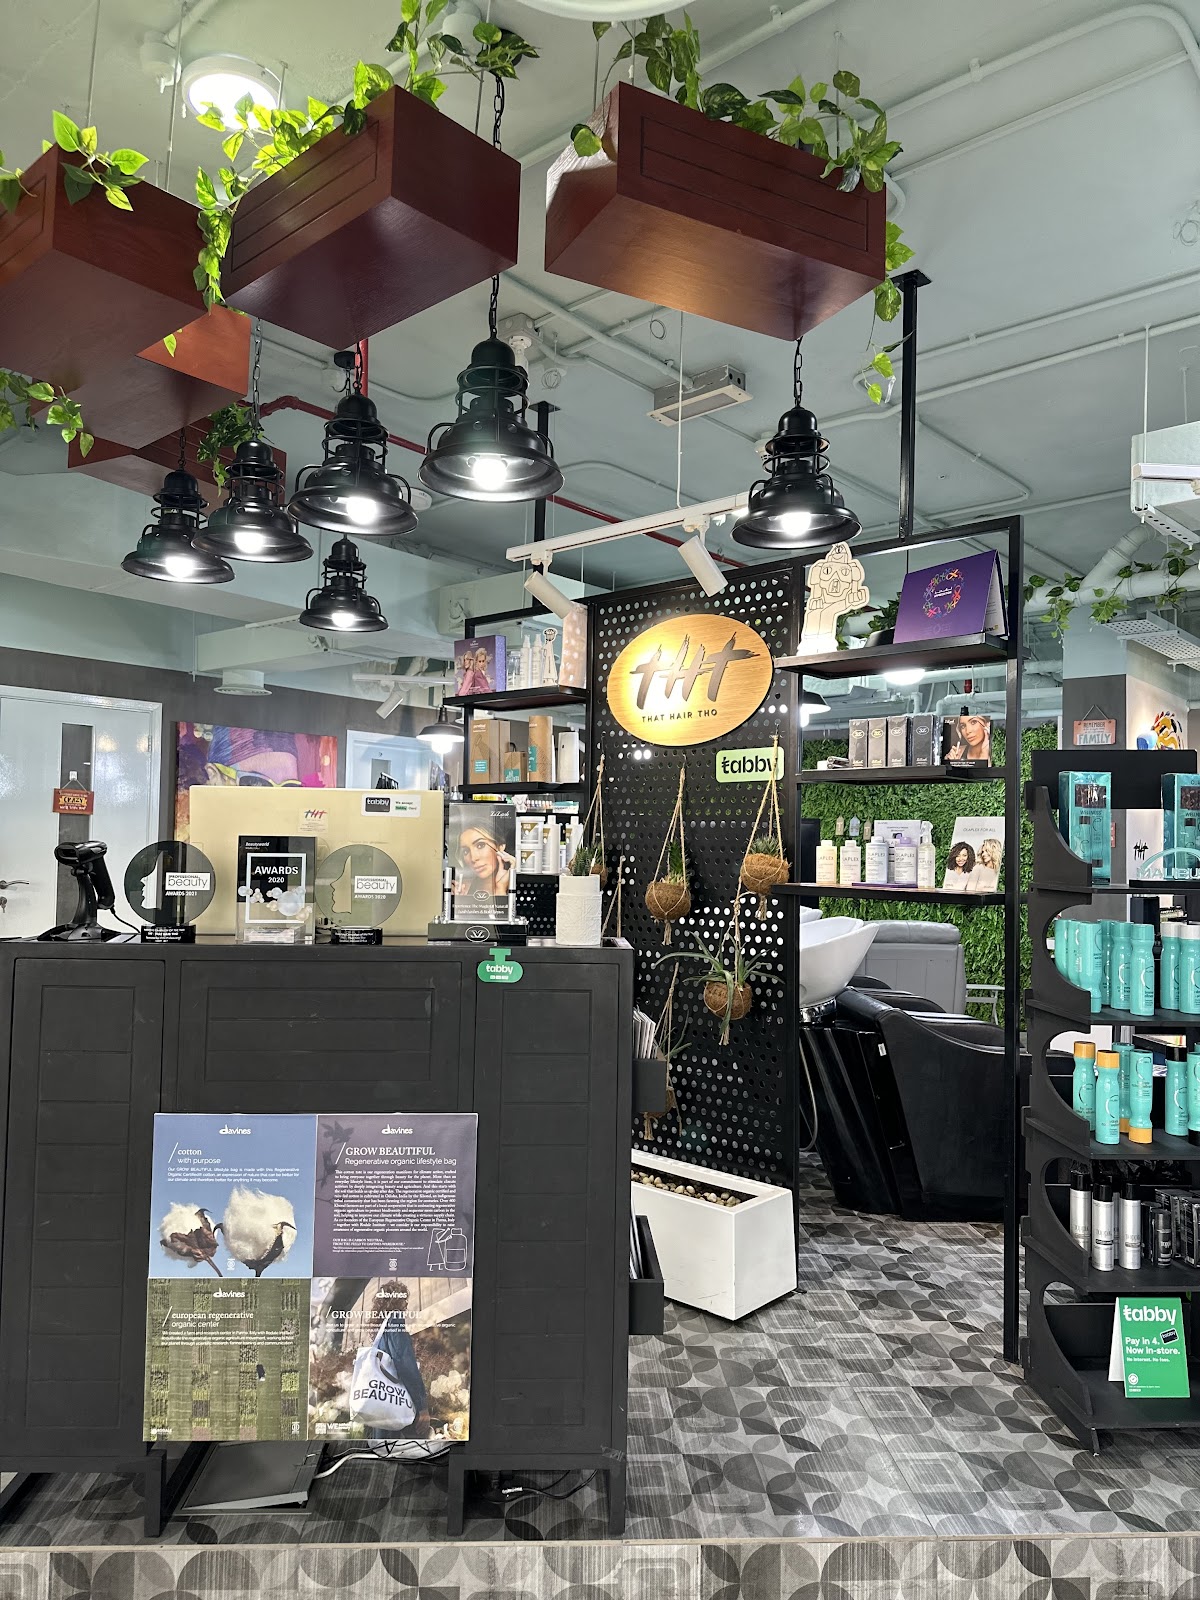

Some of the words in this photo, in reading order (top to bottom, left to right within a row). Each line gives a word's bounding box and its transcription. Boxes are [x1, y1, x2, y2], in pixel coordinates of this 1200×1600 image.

[642, 714, 665, 723] THAT
[670, 712, 693, 720] HAIR
[698, 709, 718, 717] THO
[1079, 733, 1110, 744] FAMILY
[367, 798, 390, 806] tabby
[254, 866, 299, 874] AWARDS
[168, 876, 208, 888] beauty
[356, 880, 395, 891] beauty
[486, 964, 514, 974] tabby
[219, 1124, 252, 1134] davines
[382, 1124, 413, 1134] davines
[346, 1147, 377, 1155] GROW
[379, 1147, 435, 1155] BEAUTIFUL
[345, 1158, 389, 1166] Regenerative
[391, 1158, 415, 1166] organic
[417, 1158, 442, 1166] lifestyle
[444, 1158, 457, 1166] bag
[213, 1288, 245, 1298] davines
[376, 1288, 407, 1298] davines
[208, 1312, 254, 1321] regenerative
[332, 1310, 362, 1318] GROW
[365, 1310, 421, 1319] BEAUTIFUL
[1123, 1305, 1176, 1325] tabby
[1125, 1337, 1140, 1347] Pay
[1142, 1337, 1150, 1345] in
[1126, 1346, 1144, 1354] Now
[1146, 1346, 1180, 1354] in-store.
[368, 1380, 406, 1397] GROW
